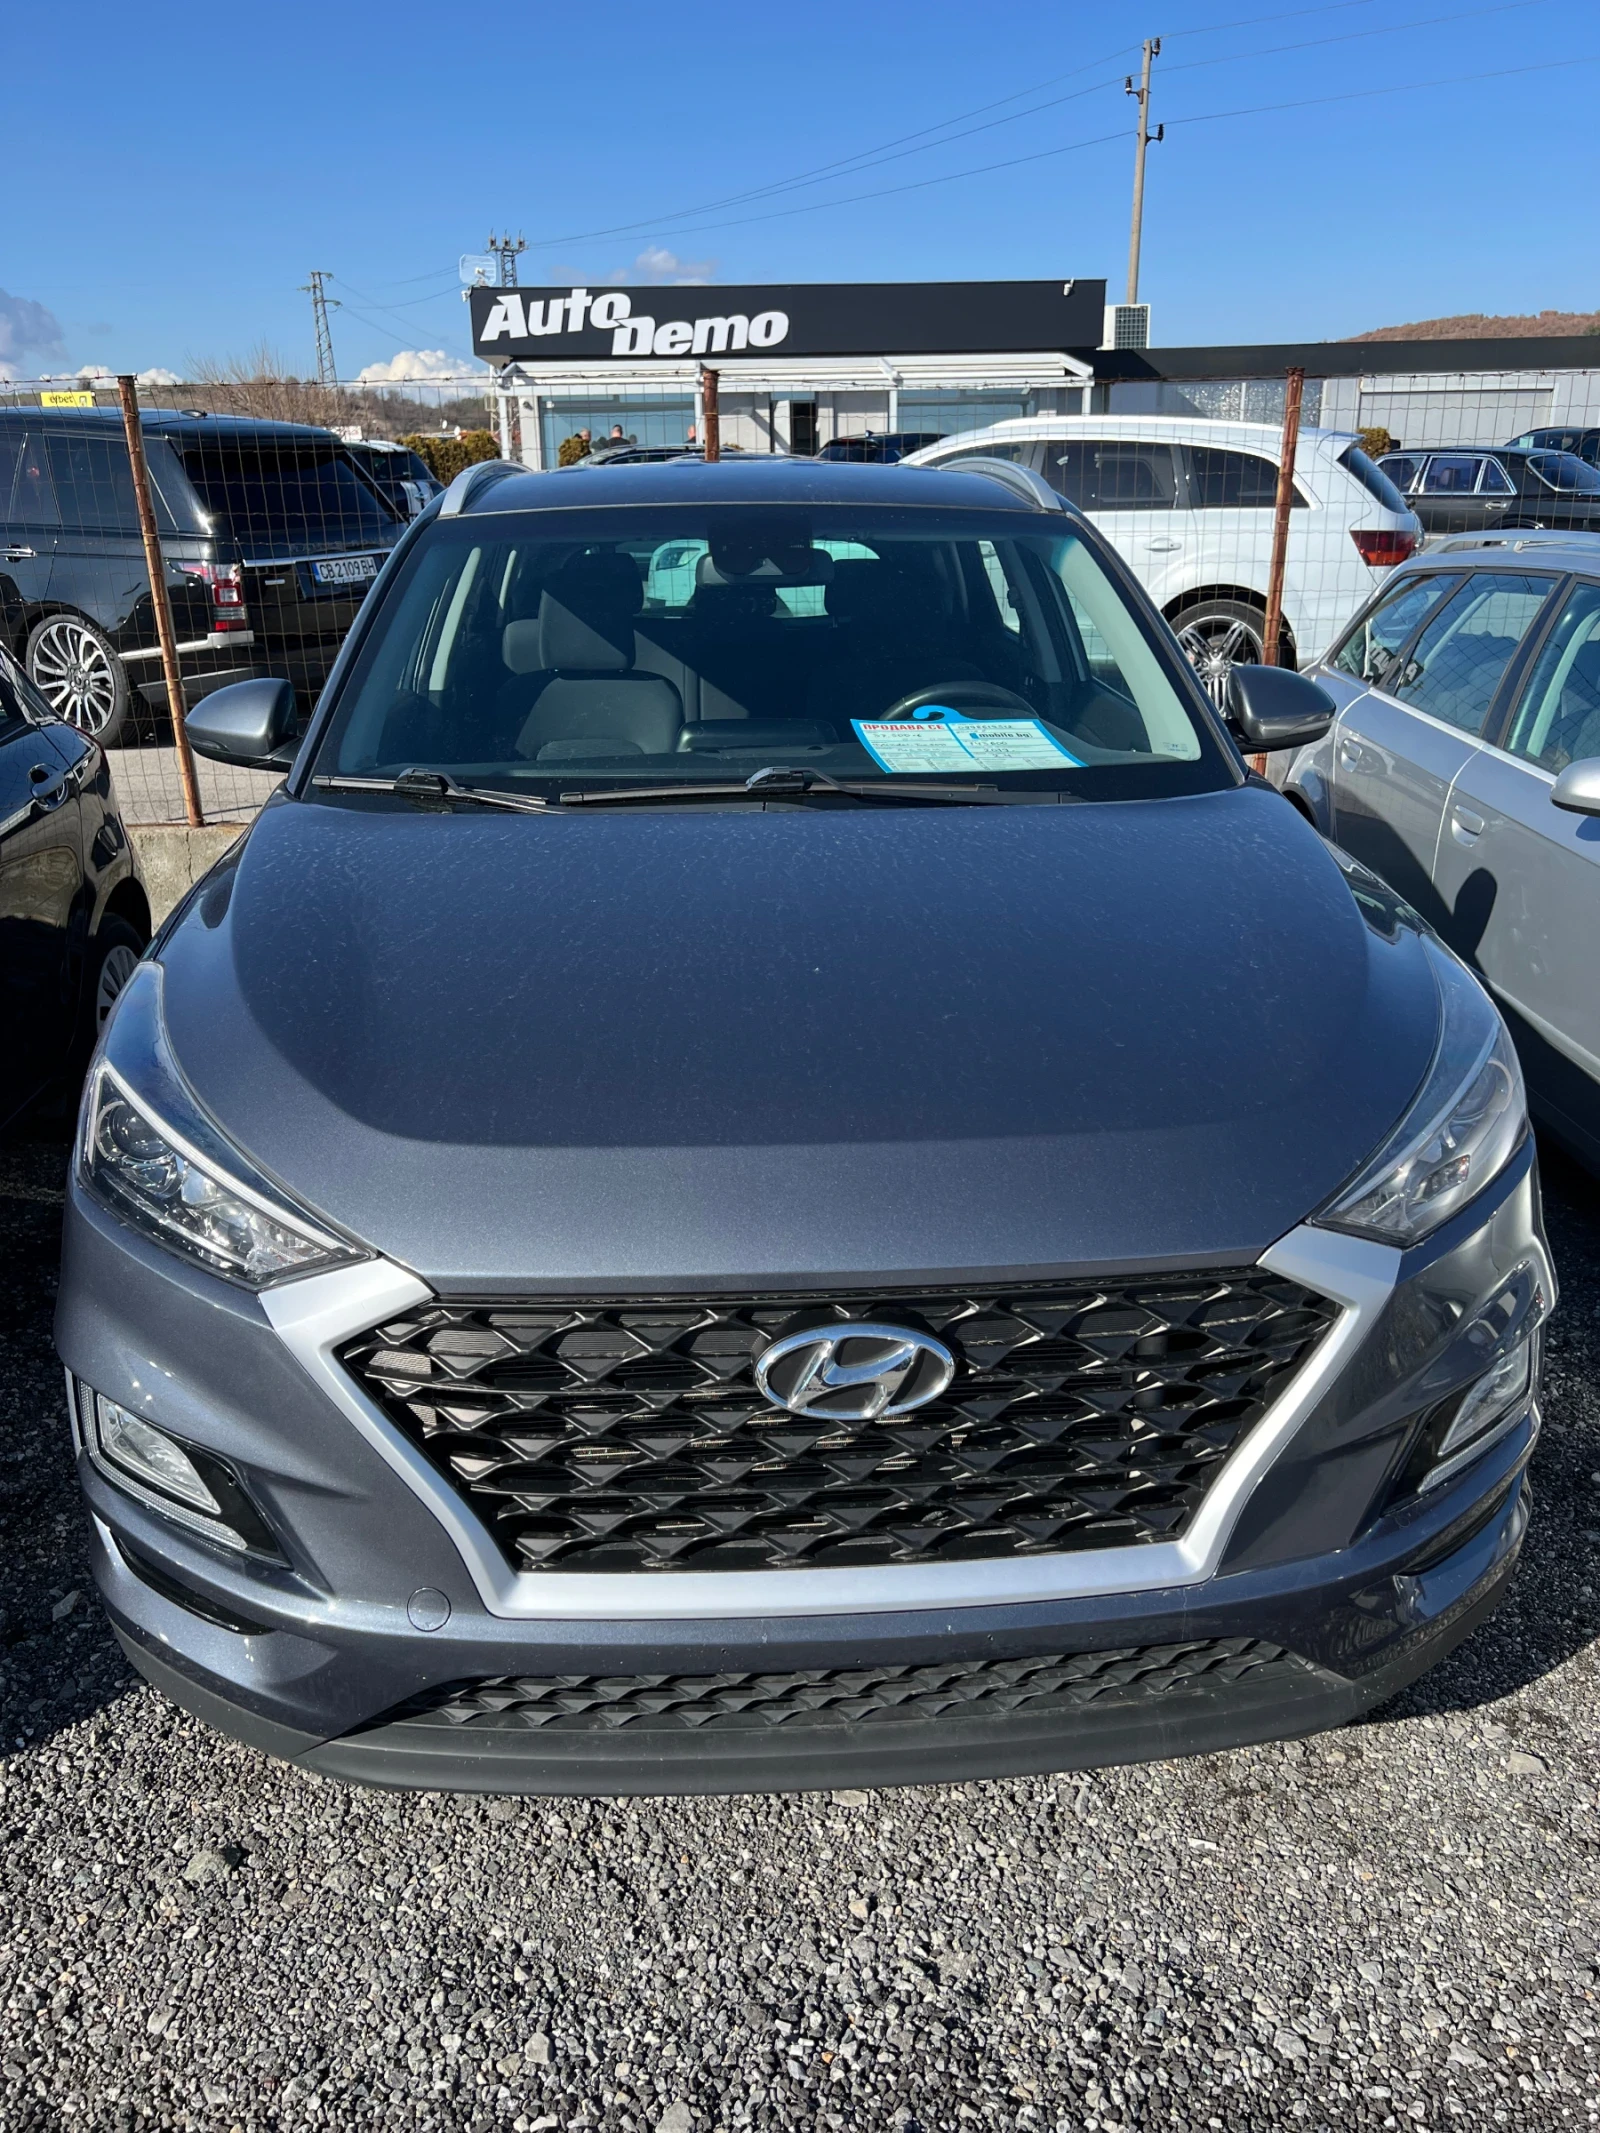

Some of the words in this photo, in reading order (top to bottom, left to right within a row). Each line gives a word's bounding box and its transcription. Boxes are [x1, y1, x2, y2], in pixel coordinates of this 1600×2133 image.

[480, 288, 631, 342] Auto
[611, 311, 789, 356] Demo
[335, 561, 360, 577] 2109
[862, 723, 925, 731] ПРОДАВА
